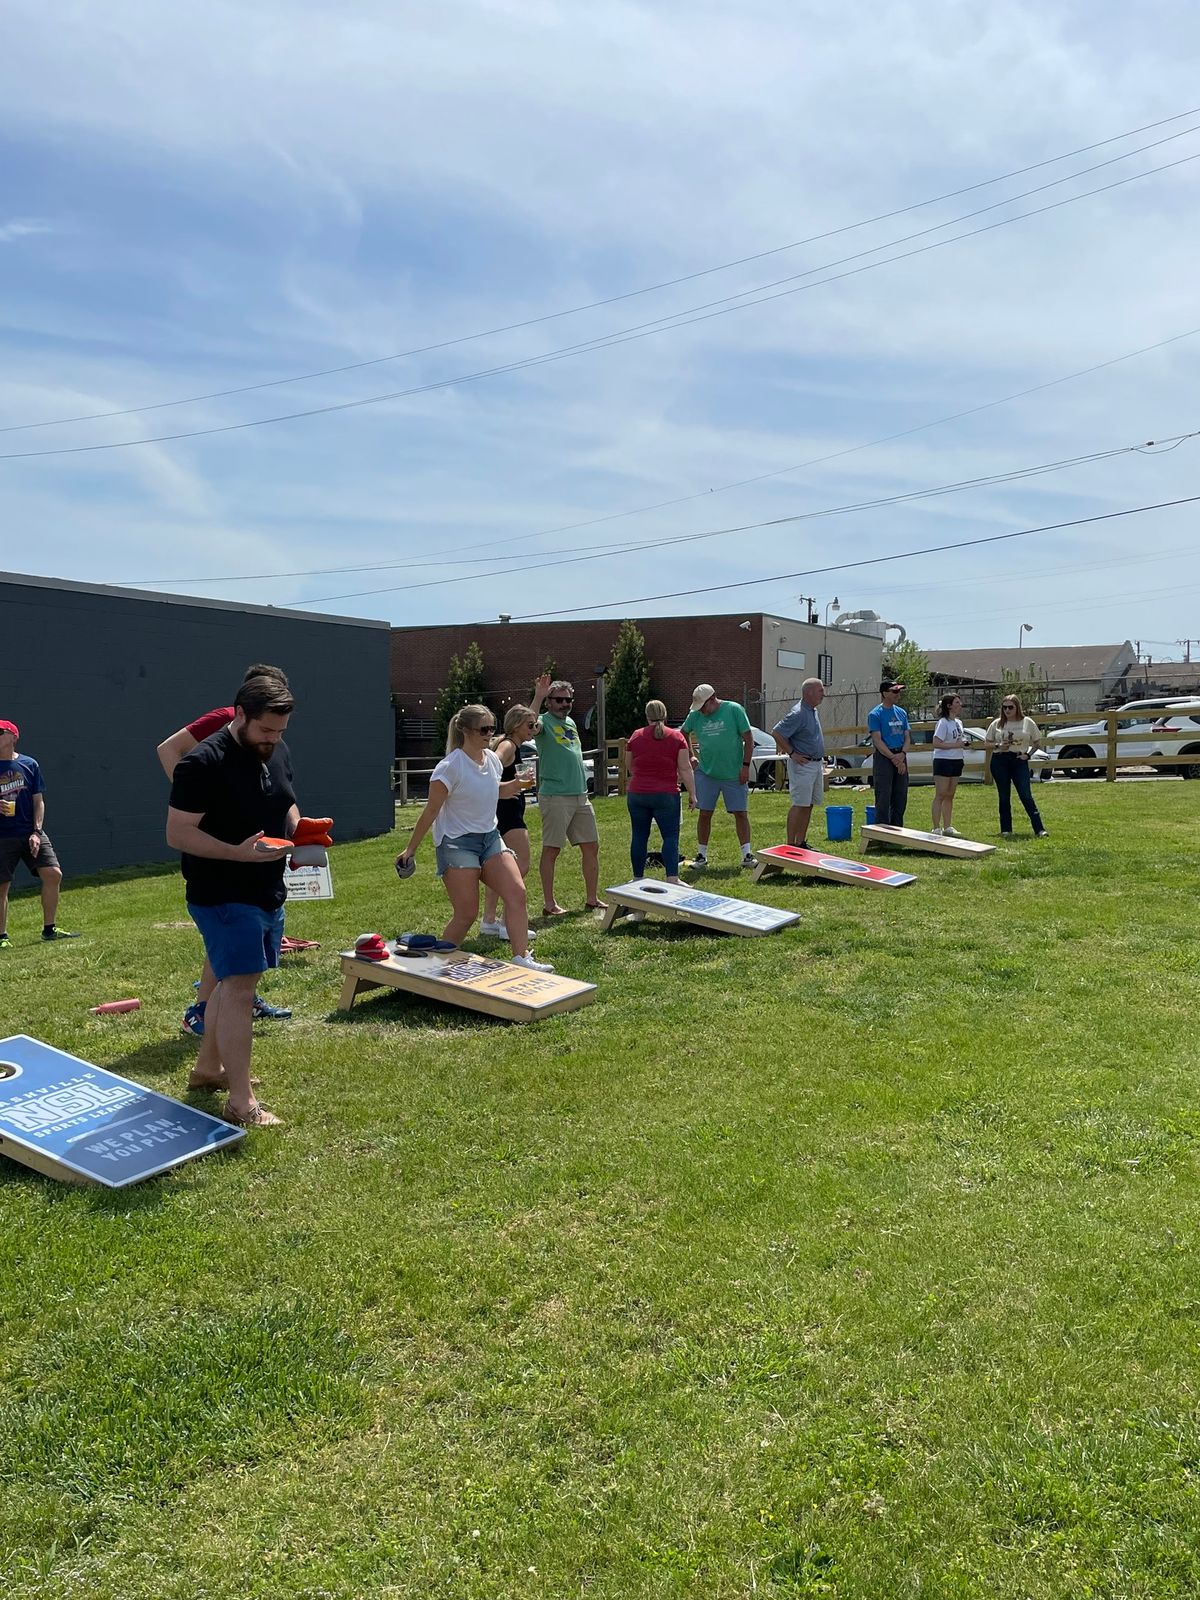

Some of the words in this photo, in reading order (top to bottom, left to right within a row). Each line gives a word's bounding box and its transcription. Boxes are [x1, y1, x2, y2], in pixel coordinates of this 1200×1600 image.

[0, 1073, 96, 1107] ASHVILLE
[0, 1081, 137, 1133] NSL
[33, 1116, 89, 1138] SPORTS
[88, 1095, 147, 1118] LEAGUES
[84, 1138, 123, 1154] WE
[119, 1118, 181, 1141] PLAN.
[101, 1143, 143, 1161] YOU
[140, 1125, 196, 1148] PLAY.
